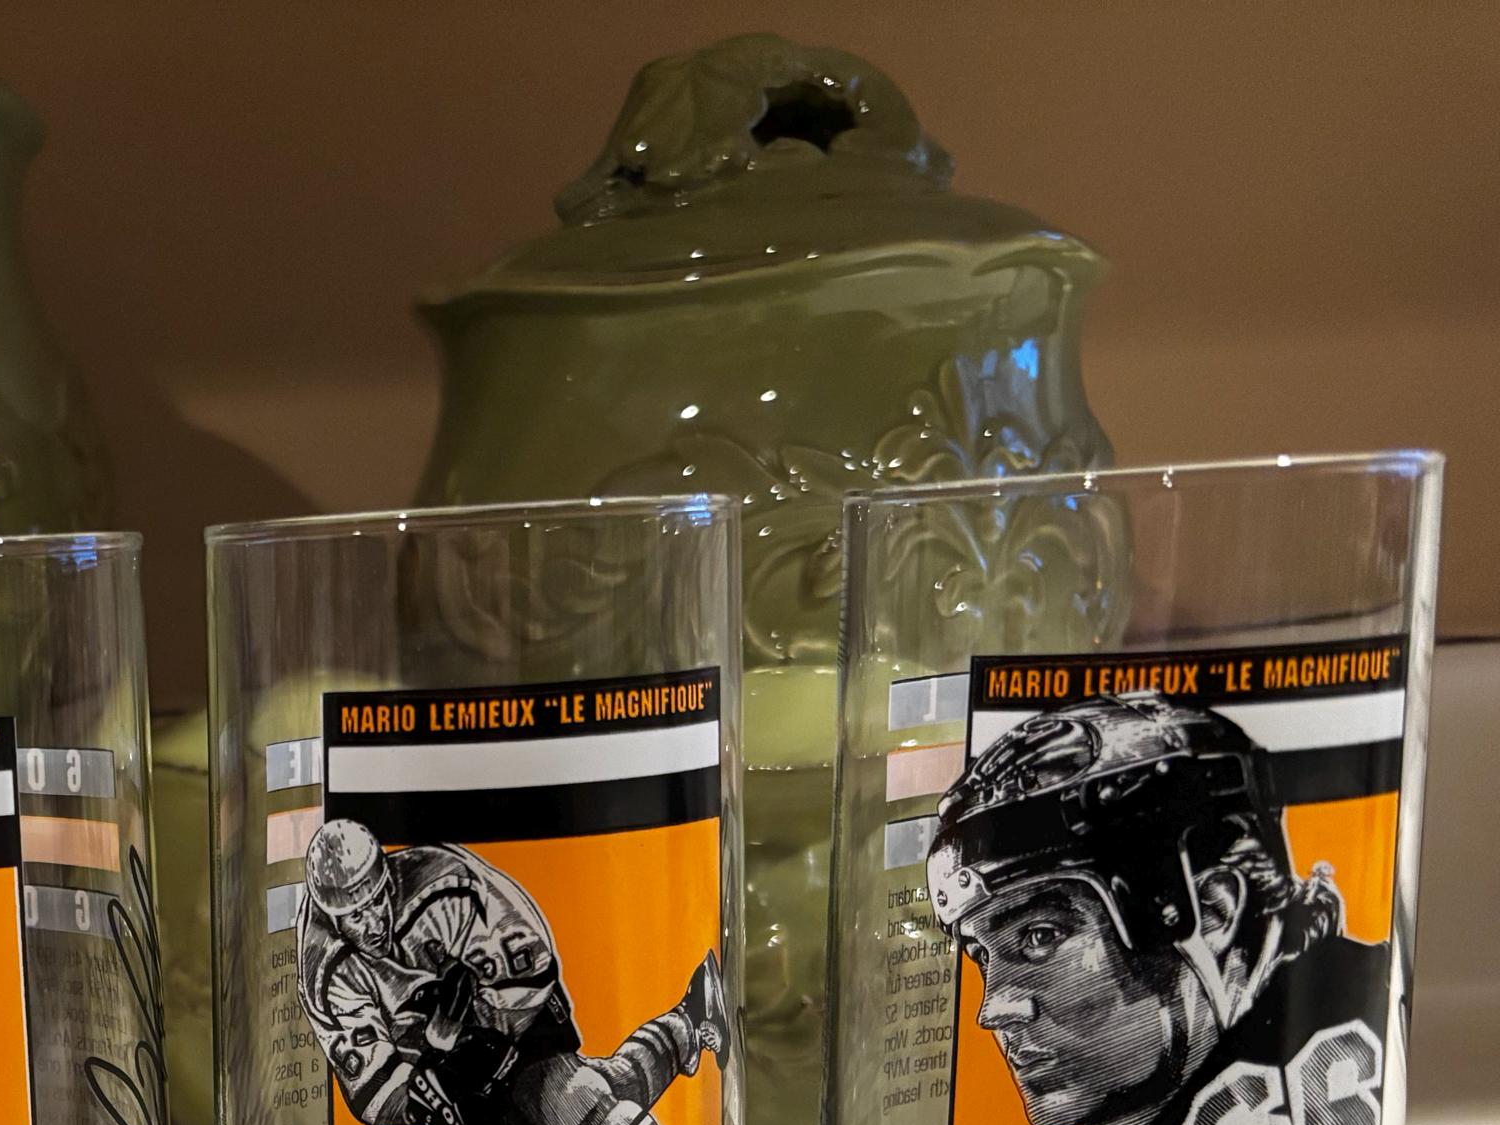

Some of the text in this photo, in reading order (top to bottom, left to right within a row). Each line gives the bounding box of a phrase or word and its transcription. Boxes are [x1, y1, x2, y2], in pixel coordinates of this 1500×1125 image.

[988, 669, 1069, 698] MARIO
[1083, 664, 1199, 697] LEMIEUX
[341, 705, 416, 734] MARIO
[429, 698, 535, 732] LEMIEUX
